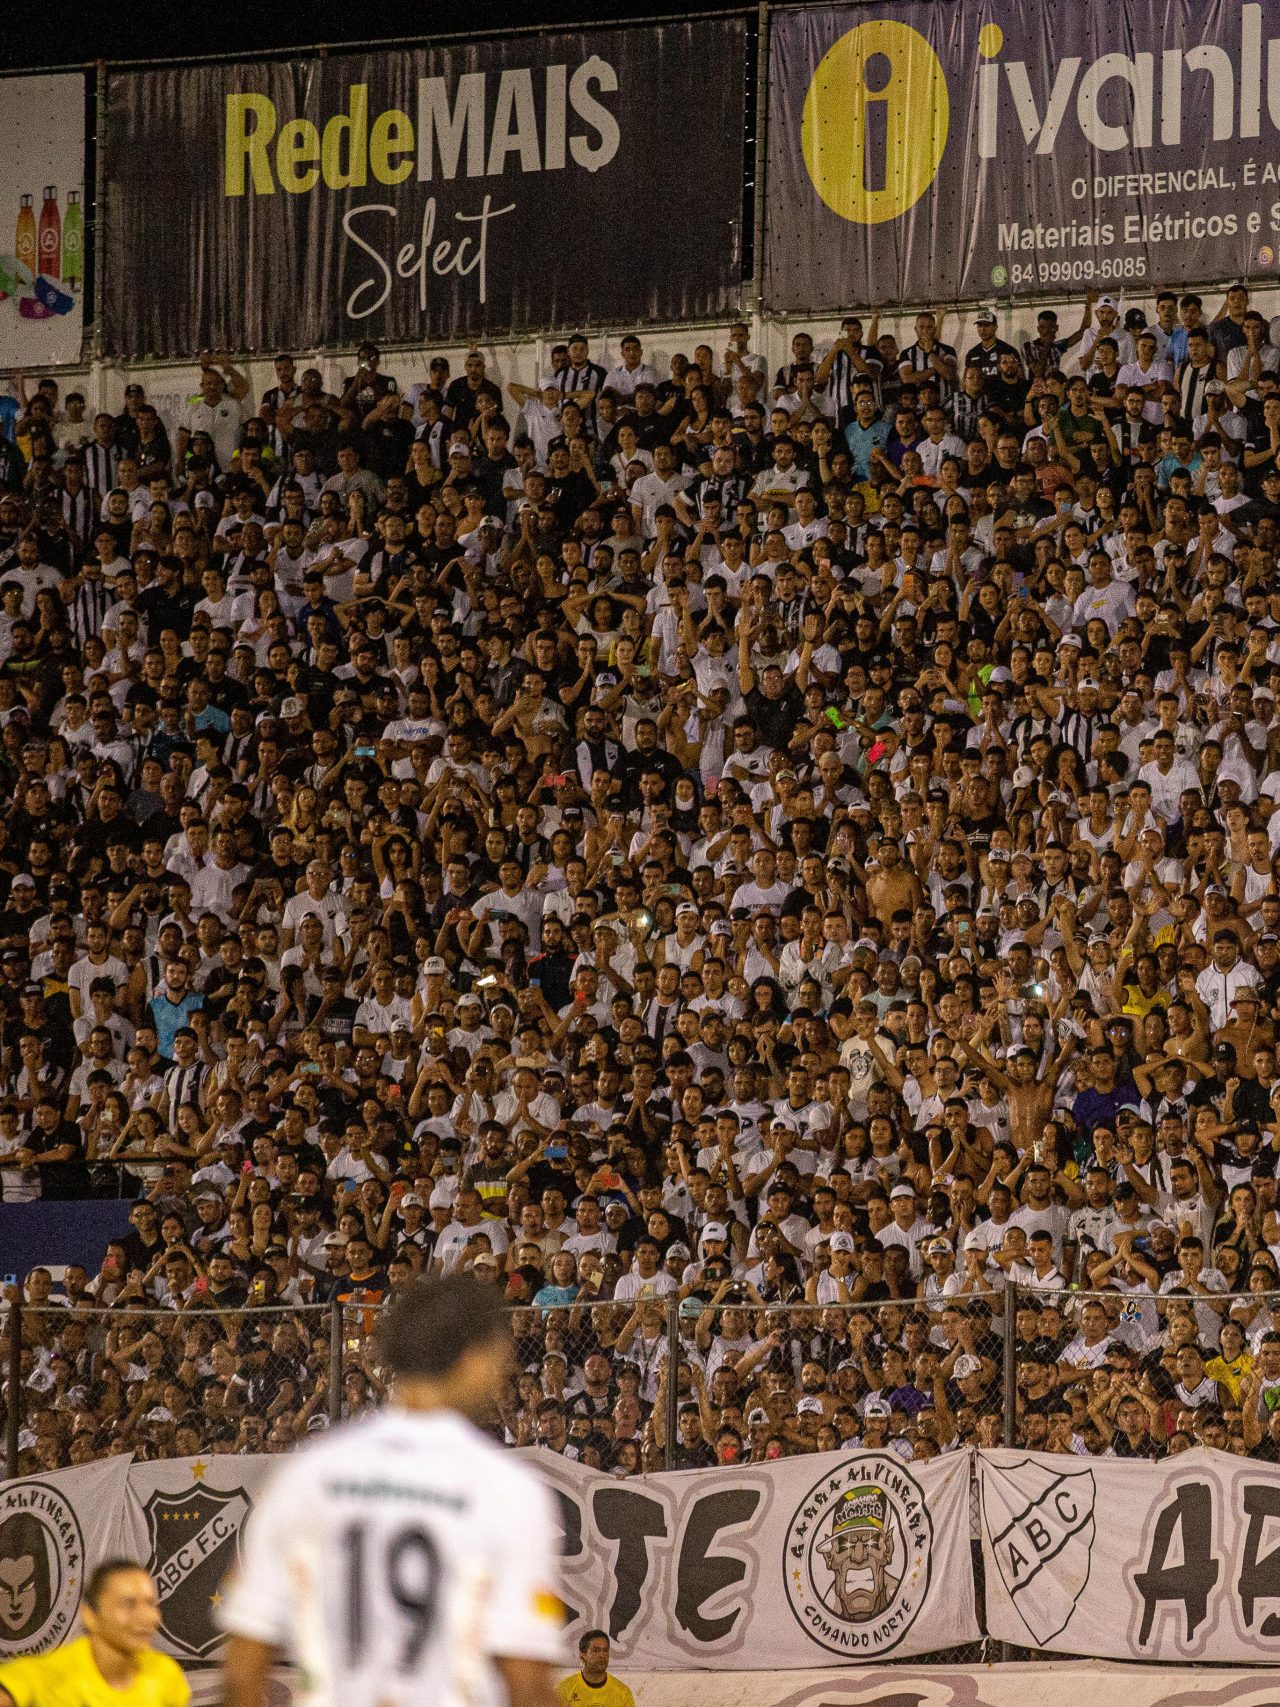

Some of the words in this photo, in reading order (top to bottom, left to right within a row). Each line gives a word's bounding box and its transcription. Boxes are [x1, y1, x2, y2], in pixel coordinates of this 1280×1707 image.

[1071, 177, 1087, 200] O
[1093, 166, 1236, 199] DIFERENCIAL,
[1243, 158, 1256, 186] É
[997, 219, 1115, 252] Materiais
[1123, 211, 1238, 244] Elétricos
[1247, 213, 1262, 233] e
[342, 196, 515, 319] Select
[1011, 263, 1034, 284] 84
[1039, 256, 1147, 283] 99909-6085
[156, 1549, 194, 1599] ABC
[195, 1517, 236, 1556] F.C.
[344, 1512, 444, 1676] 19
[804, 1604, 869, 1648] COMANDO
[873, 1598, 912, 1644] NORTE
